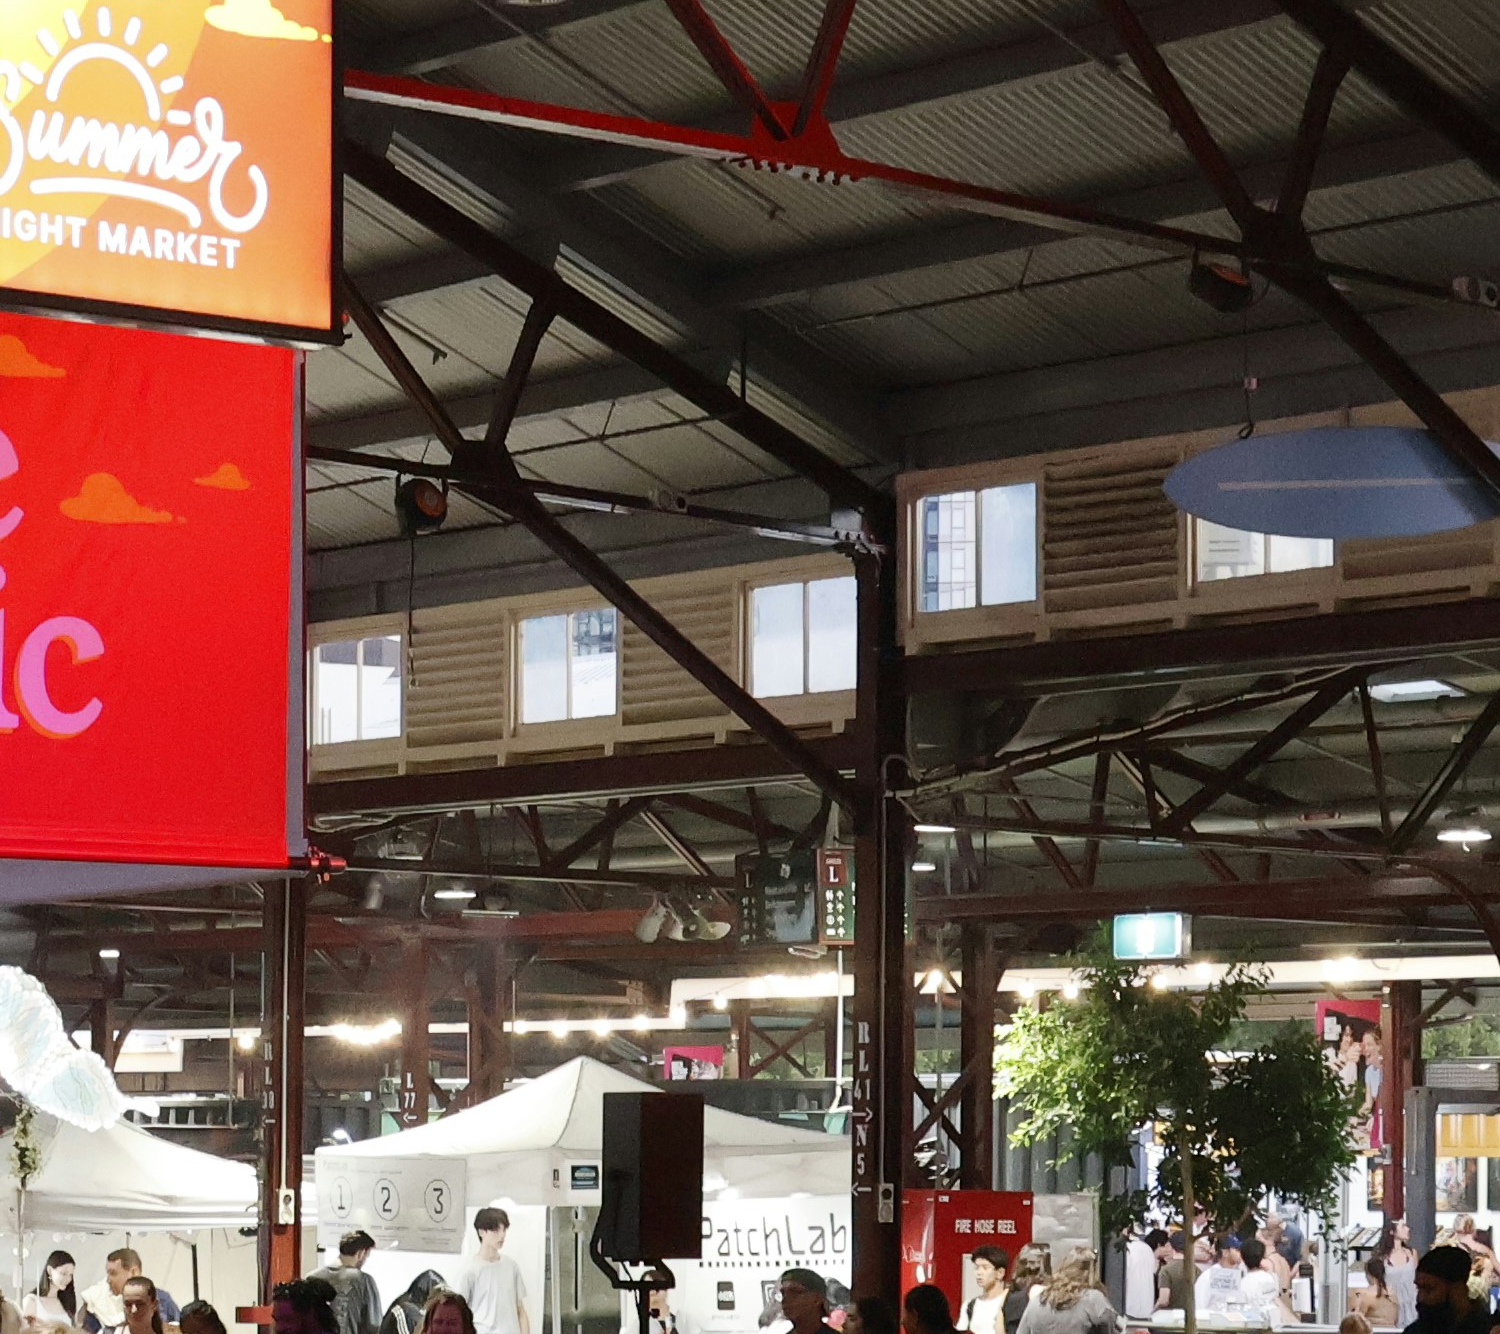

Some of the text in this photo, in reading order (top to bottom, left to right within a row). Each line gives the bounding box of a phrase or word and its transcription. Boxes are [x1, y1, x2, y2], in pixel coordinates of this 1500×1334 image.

[97, 220, 241, 269] MARKET
[829, 866, 839, 883] L
[858, 1021, 870, 1044] R
[859, 1051, 869, 1073] L
[406, 1072, 413, 1089] L
[854, 1077, 871, 1101] 41
[404, 1092, 416, 1108] 77
[856, 1124, 869, 1147] N
[856, 1153, 865, 1175] 5
[336, 1184, 346, 1211] 1
[381, 1186, 393, 1213] 2
[432, 1187, 444, 1214] 3
[701, 1213, 848, 1257] PatchLab
[955, 1219, 1017, 1234] FIRE HOSE REEL
